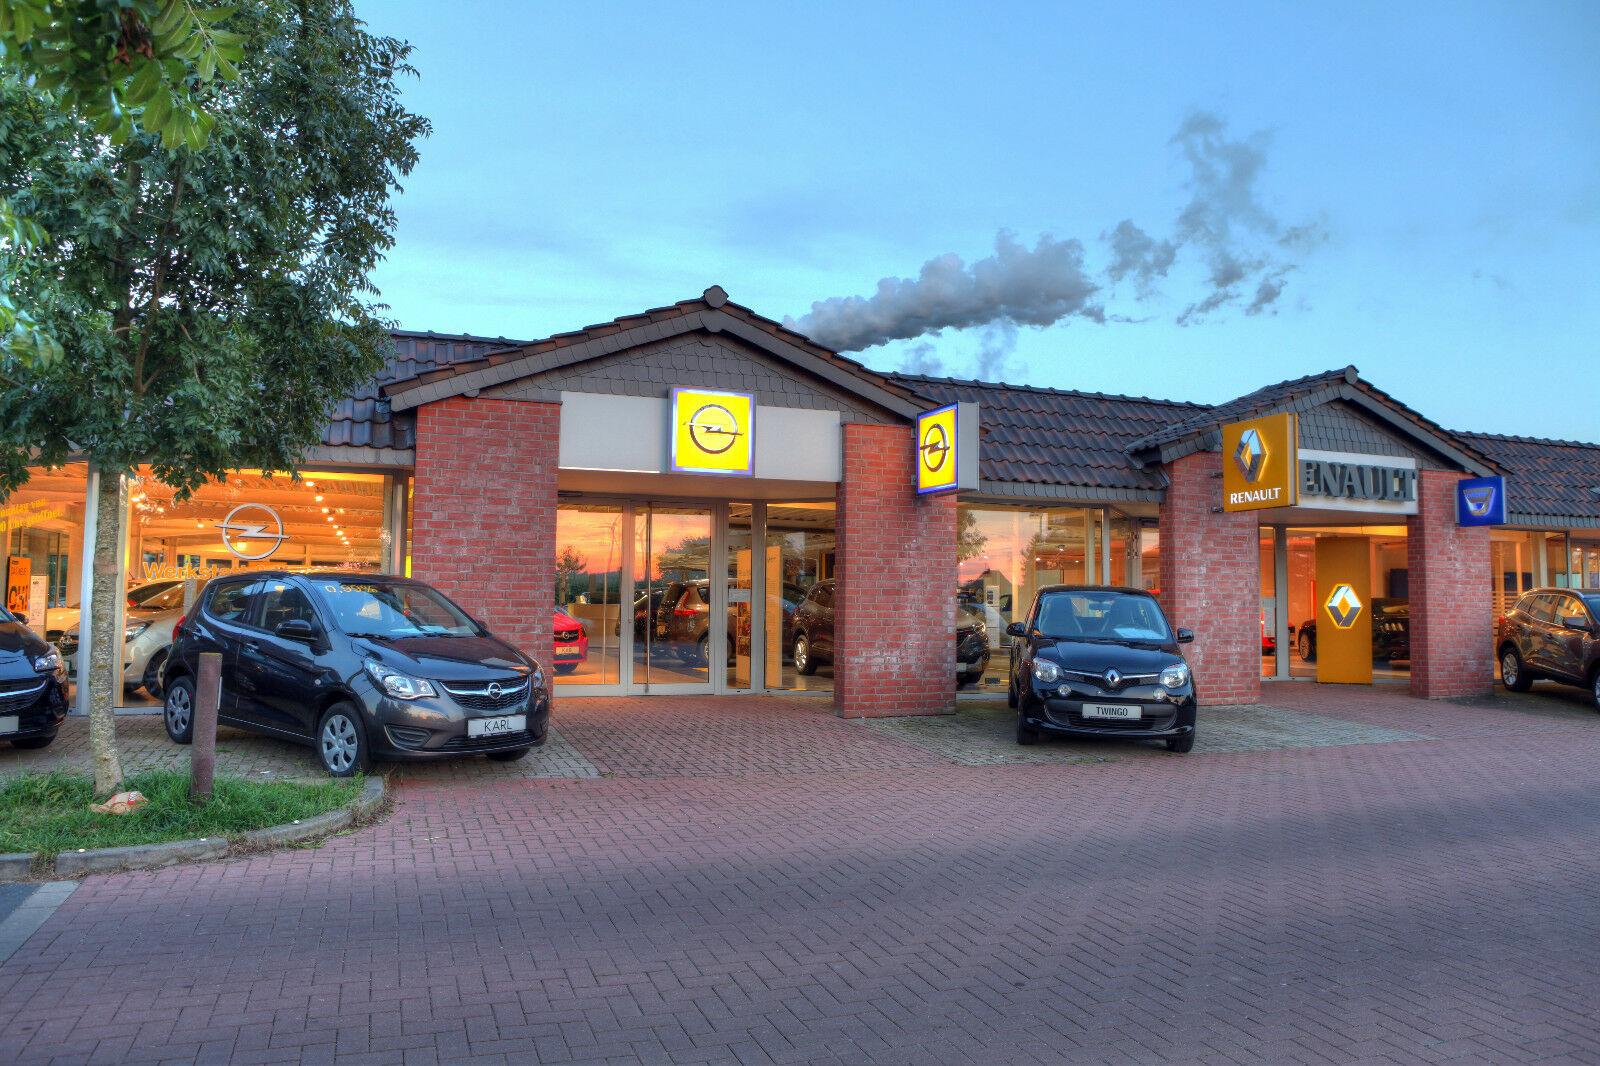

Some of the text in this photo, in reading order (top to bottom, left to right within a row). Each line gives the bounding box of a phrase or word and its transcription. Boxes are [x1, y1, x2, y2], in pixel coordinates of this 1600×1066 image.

[1299, 459, 1417, 501] ENAULT
[1230, 487, 1281, 504] RENAULT
[1096, 707, 1128, 716] TWINGO
[484, 719, 512, 732] KARL
